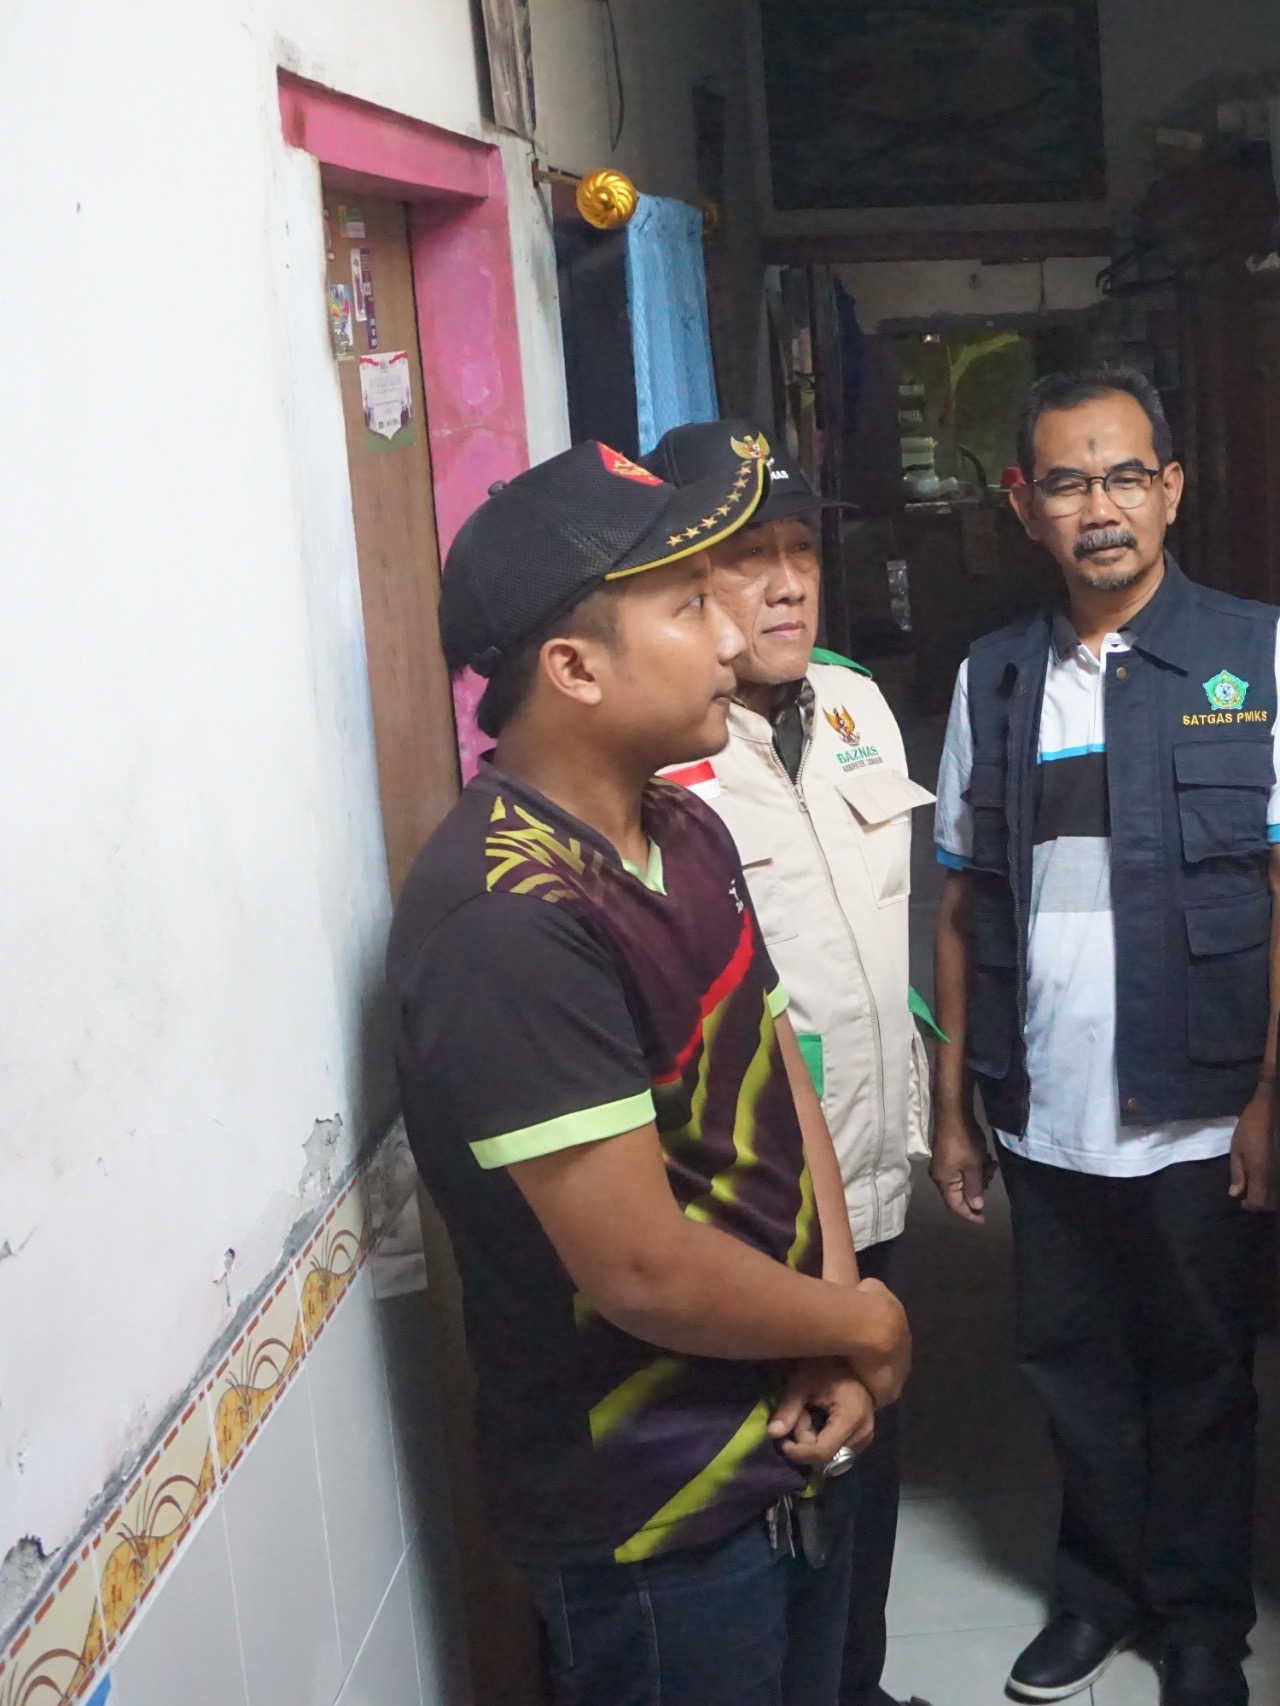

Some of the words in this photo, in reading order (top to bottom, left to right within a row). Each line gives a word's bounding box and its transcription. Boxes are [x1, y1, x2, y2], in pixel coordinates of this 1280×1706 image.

[1182, 713, 1233, 726] SATGAS
[1237, 710, 1268, 723] PMKS
[836, 745, 879, 764] BAZNAS
